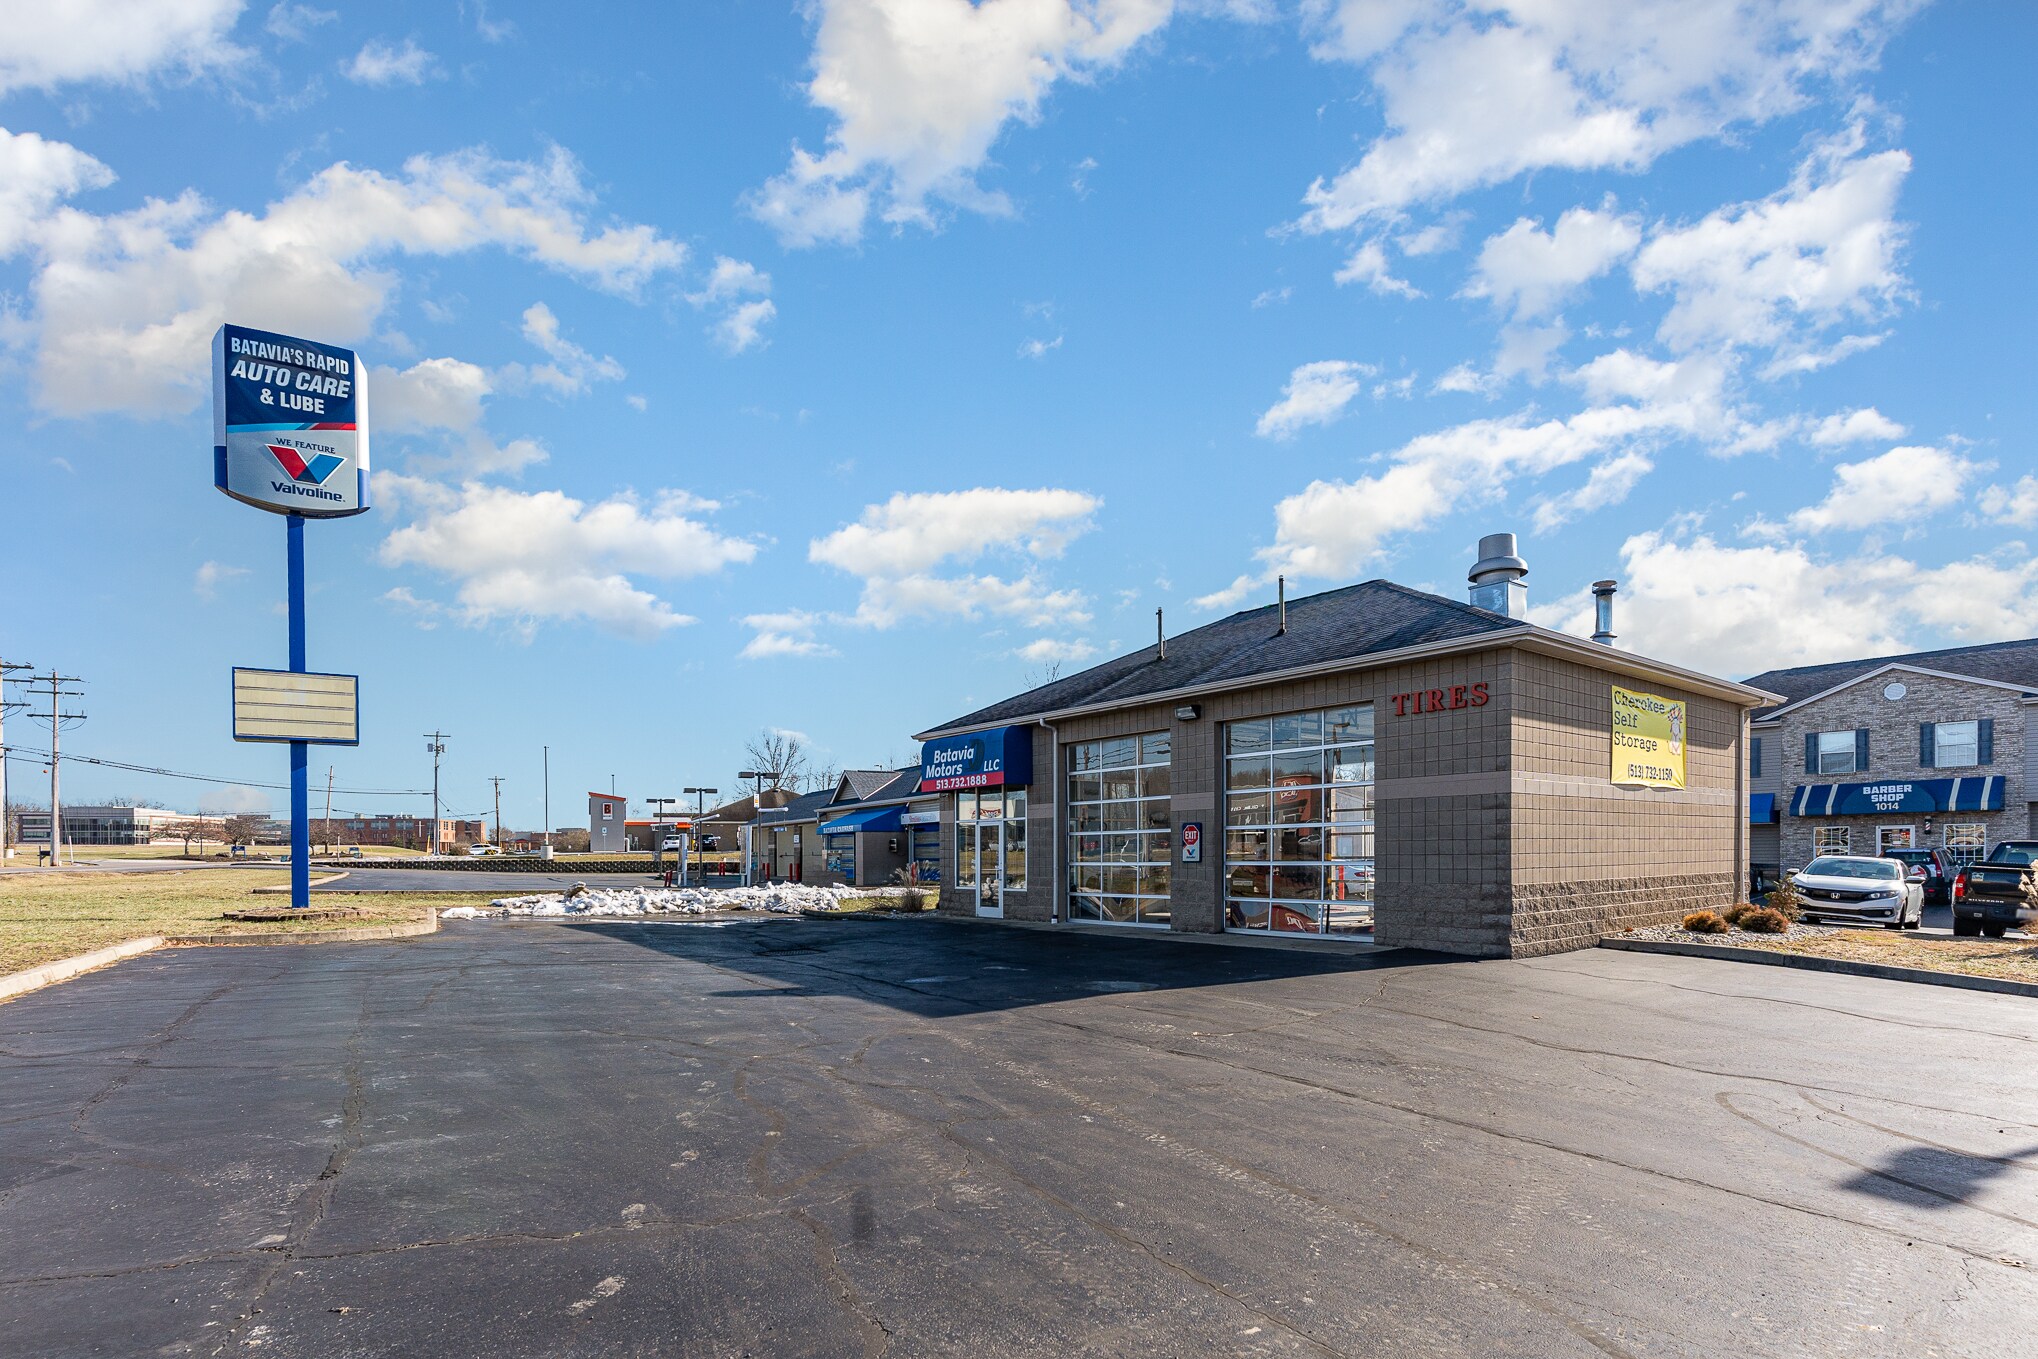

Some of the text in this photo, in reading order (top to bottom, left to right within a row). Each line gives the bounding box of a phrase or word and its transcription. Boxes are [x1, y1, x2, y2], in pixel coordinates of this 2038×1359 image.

[231, 336, 350, 376] BATAVIA'S RAPID
[230, 359, 351, 399] AUTO CARE
[260, 387, 325, 415] & LUBE
[275, 437, 336, 454] WE FEATURE
[270, 480, 343, 502] Valvoline
[1391, 681, 1489, 716] TIRES
[1614, 690, 1666, 714] Cherokee
[1614, 710, 1638, 728] Self
[1614, 731, 1658, 752] Storage
[933, 745, 975, 764] Batavia
[925, 759, 1000, 779] Motors LLC
[1627, 763, 1644, 779] (513)
[935, 774, 987, 790] 513.732.1888
[1862, 784, 1913, 795] BARBER
[1870, 793, 1905, 802] SHOP
[1875, 802, 1900, 811] 1014
[1184, 830, 1197, 840] EXIT
